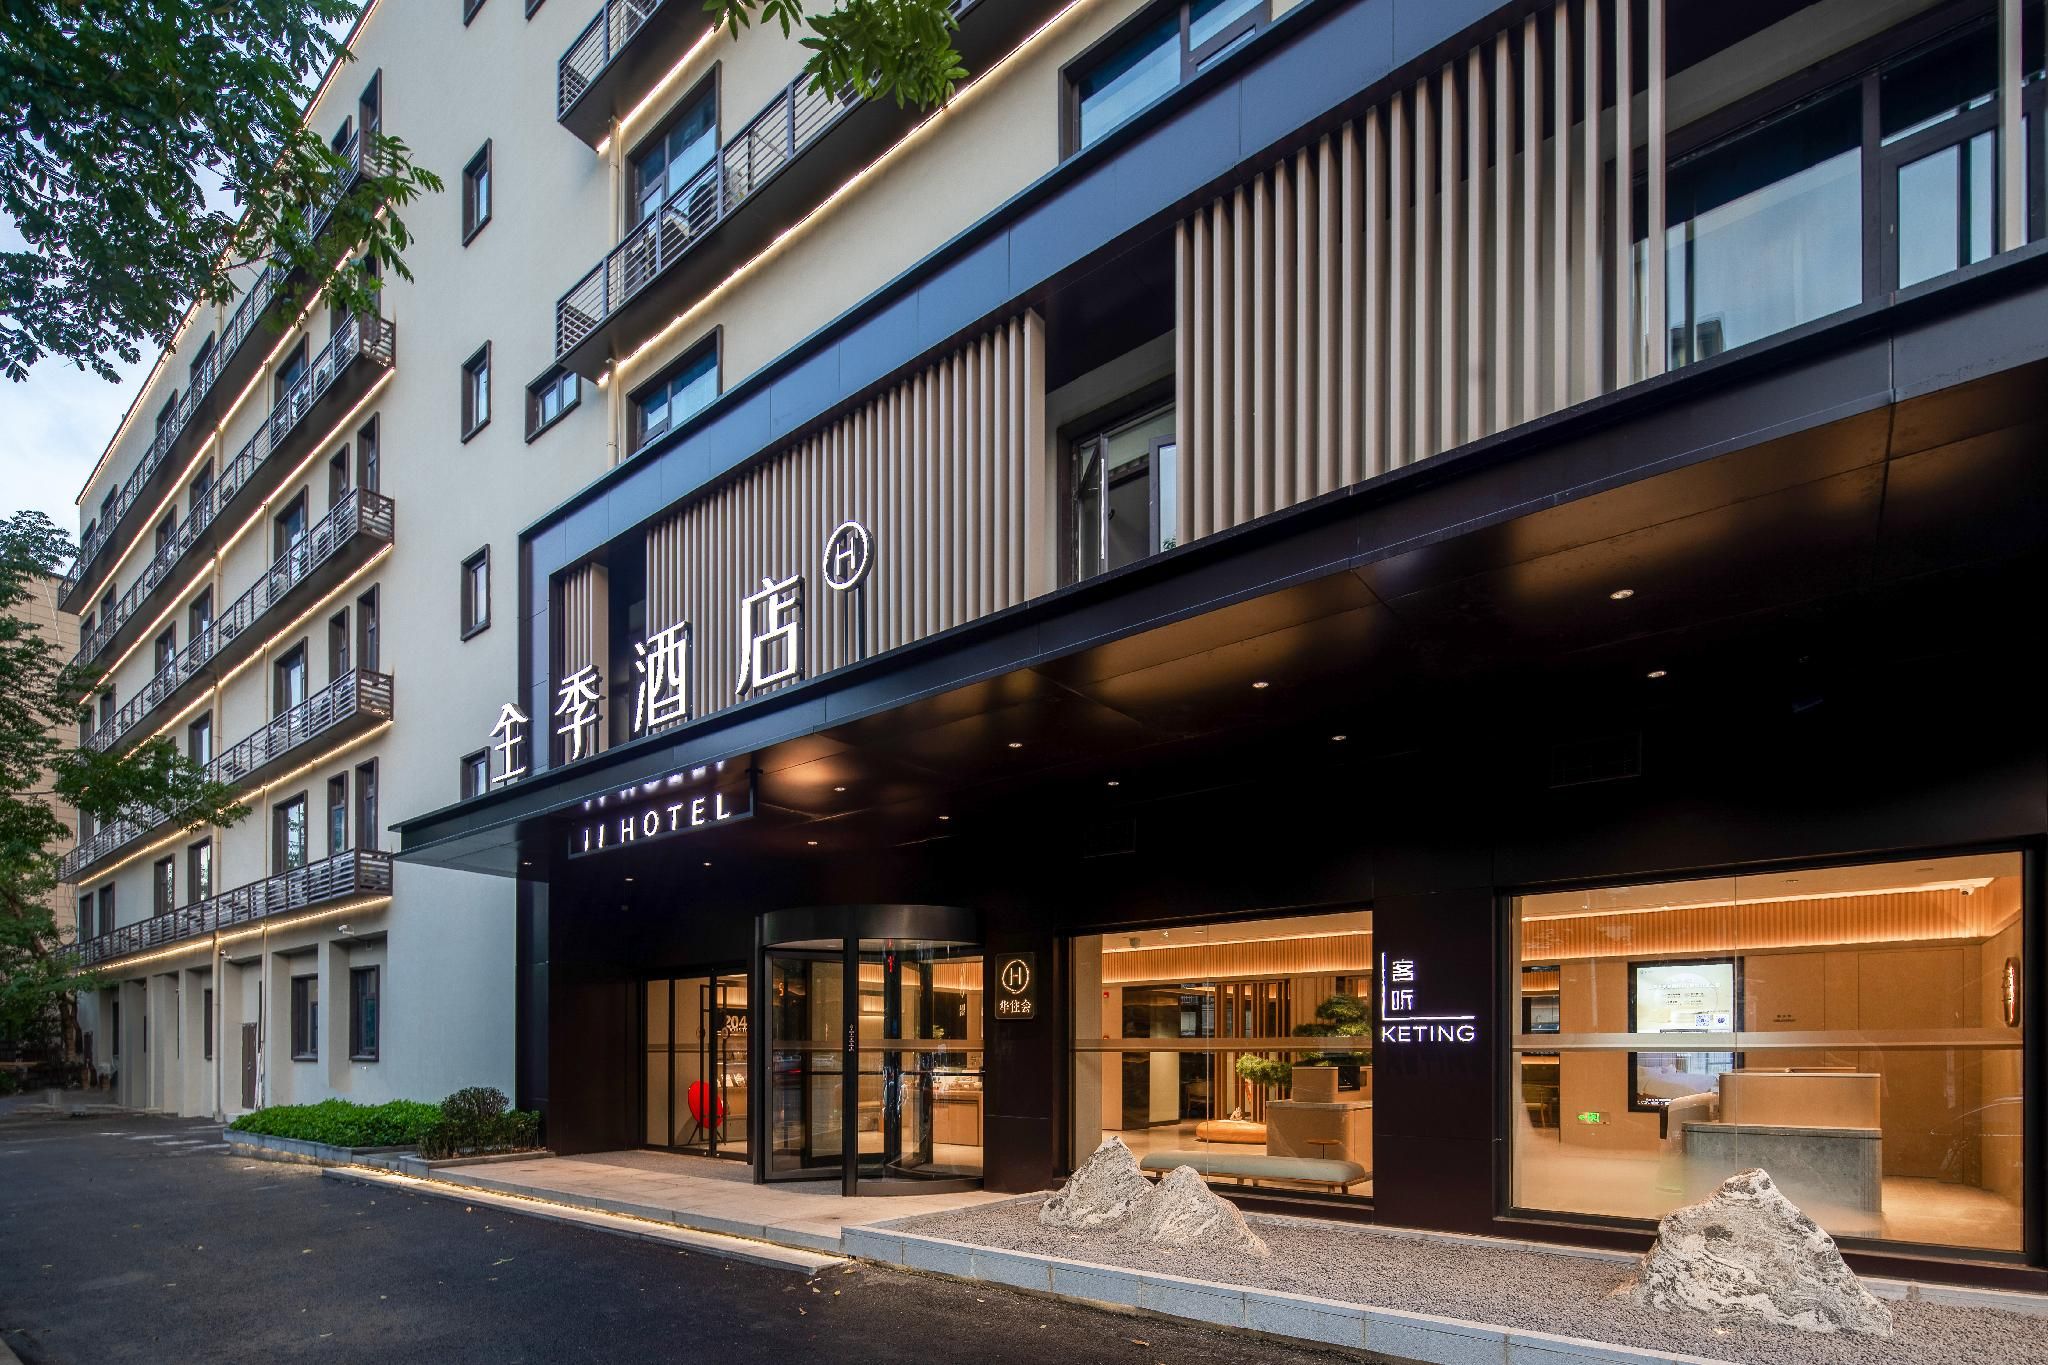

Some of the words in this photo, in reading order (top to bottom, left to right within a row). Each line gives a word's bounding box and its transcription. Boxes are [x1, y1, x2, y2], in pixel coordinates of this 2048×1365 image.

[489, 574, 804, 784] 全季酒店
[621, 794, 731, 843] HOTEL
[999, 998, 1032, 1014] 华住会
[1381, 1025, 1476, 1043] KETING
